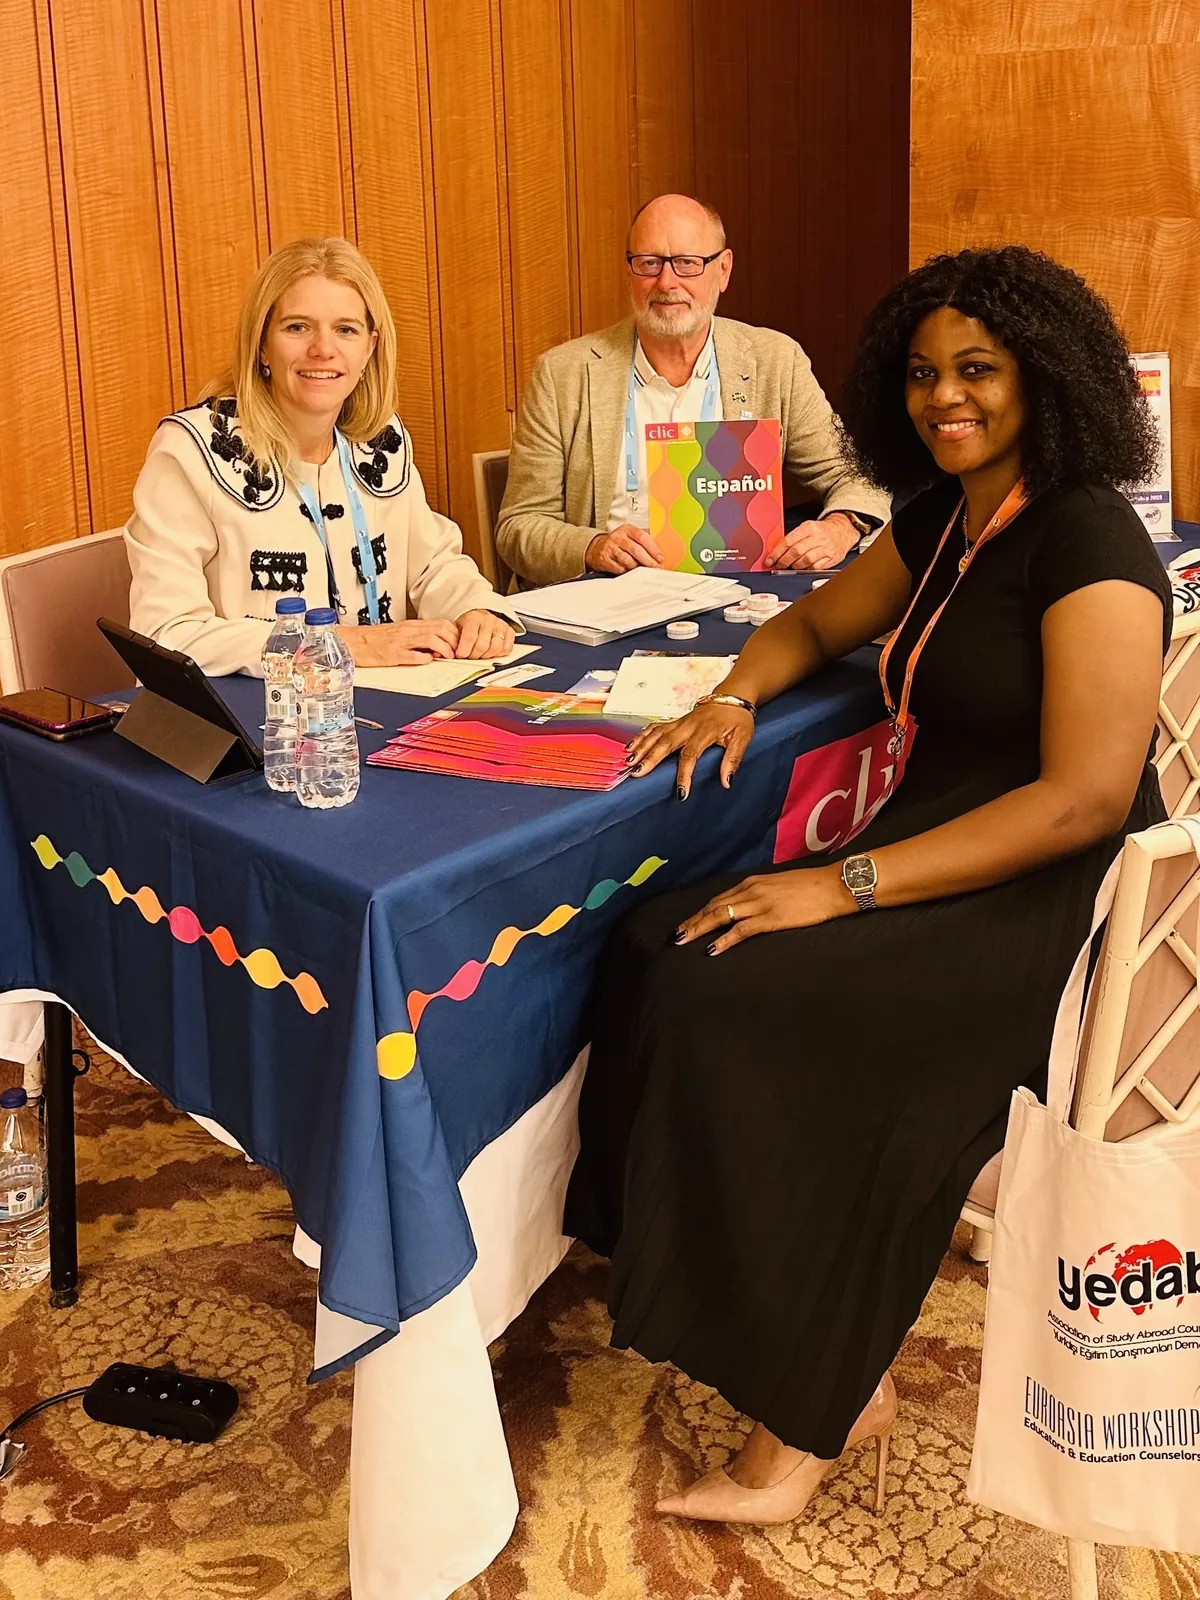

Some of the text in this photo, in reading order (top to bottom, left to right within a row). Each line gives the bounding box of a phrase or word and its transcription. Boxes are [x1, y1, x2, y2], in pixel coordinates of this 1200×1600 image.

[648, 426, 675, 439] clic
[696, 475, 773, 498] Español
[411, 718, 438, 731] clic
[1047, 1309, 1200, 1344] Association of Study Abroad Cou
[1079, 1346, 1108, 1360] Eğitim
[1025, 1376, 1200, 1450] EUROASIA WORKSHOP
[1024, 1416, 1200, 1463] Educators & Education Counselors
